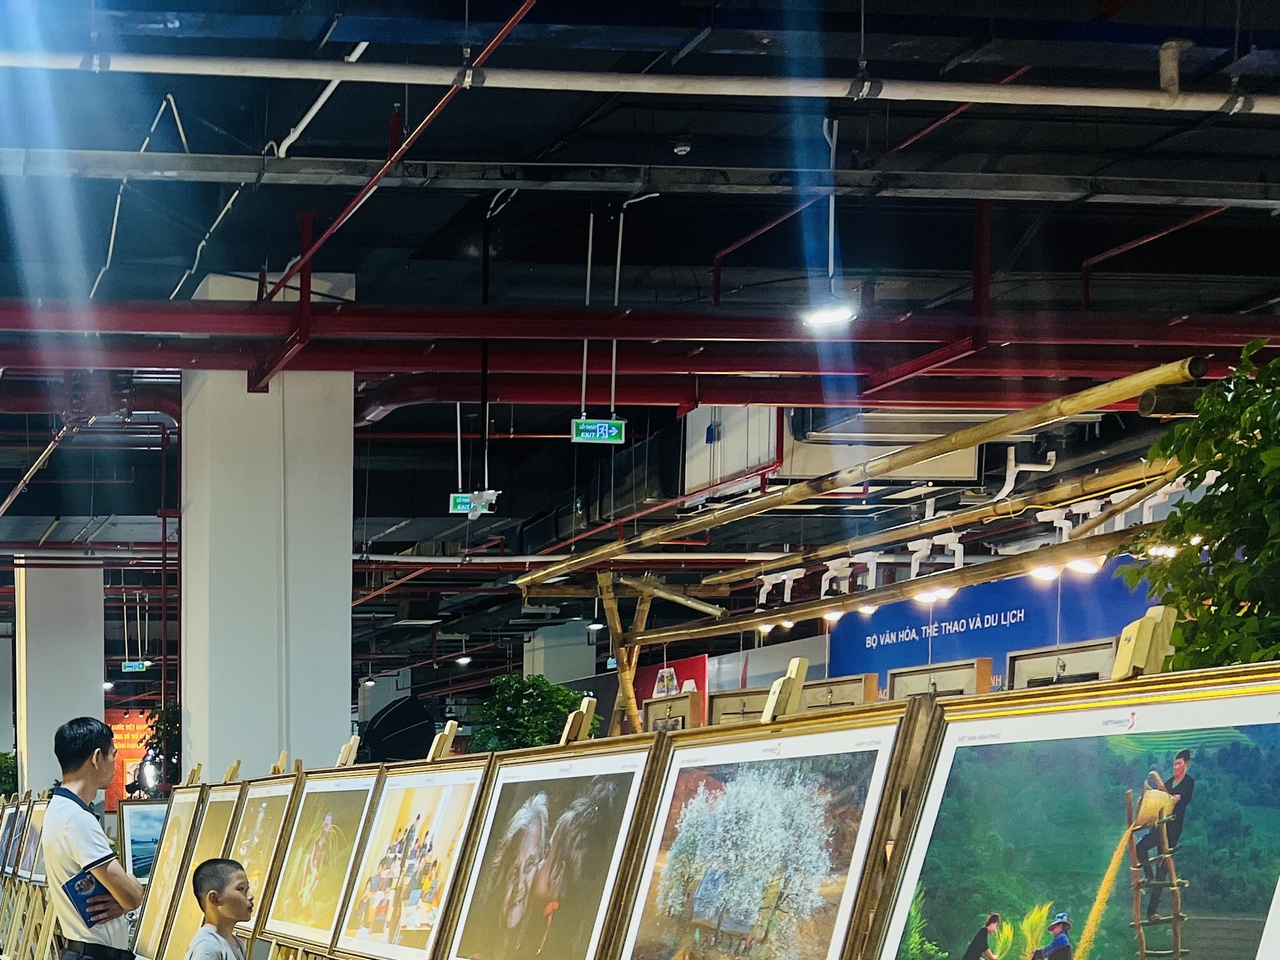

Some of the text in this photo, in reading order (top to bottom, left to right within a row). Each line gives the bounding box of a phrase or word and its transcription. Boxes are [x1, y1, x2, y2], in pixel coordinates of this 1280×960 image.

[866, 608, 1025, 650] BỘ VĂN HÓA, THỂ THAO VÀ DU LỊCH
